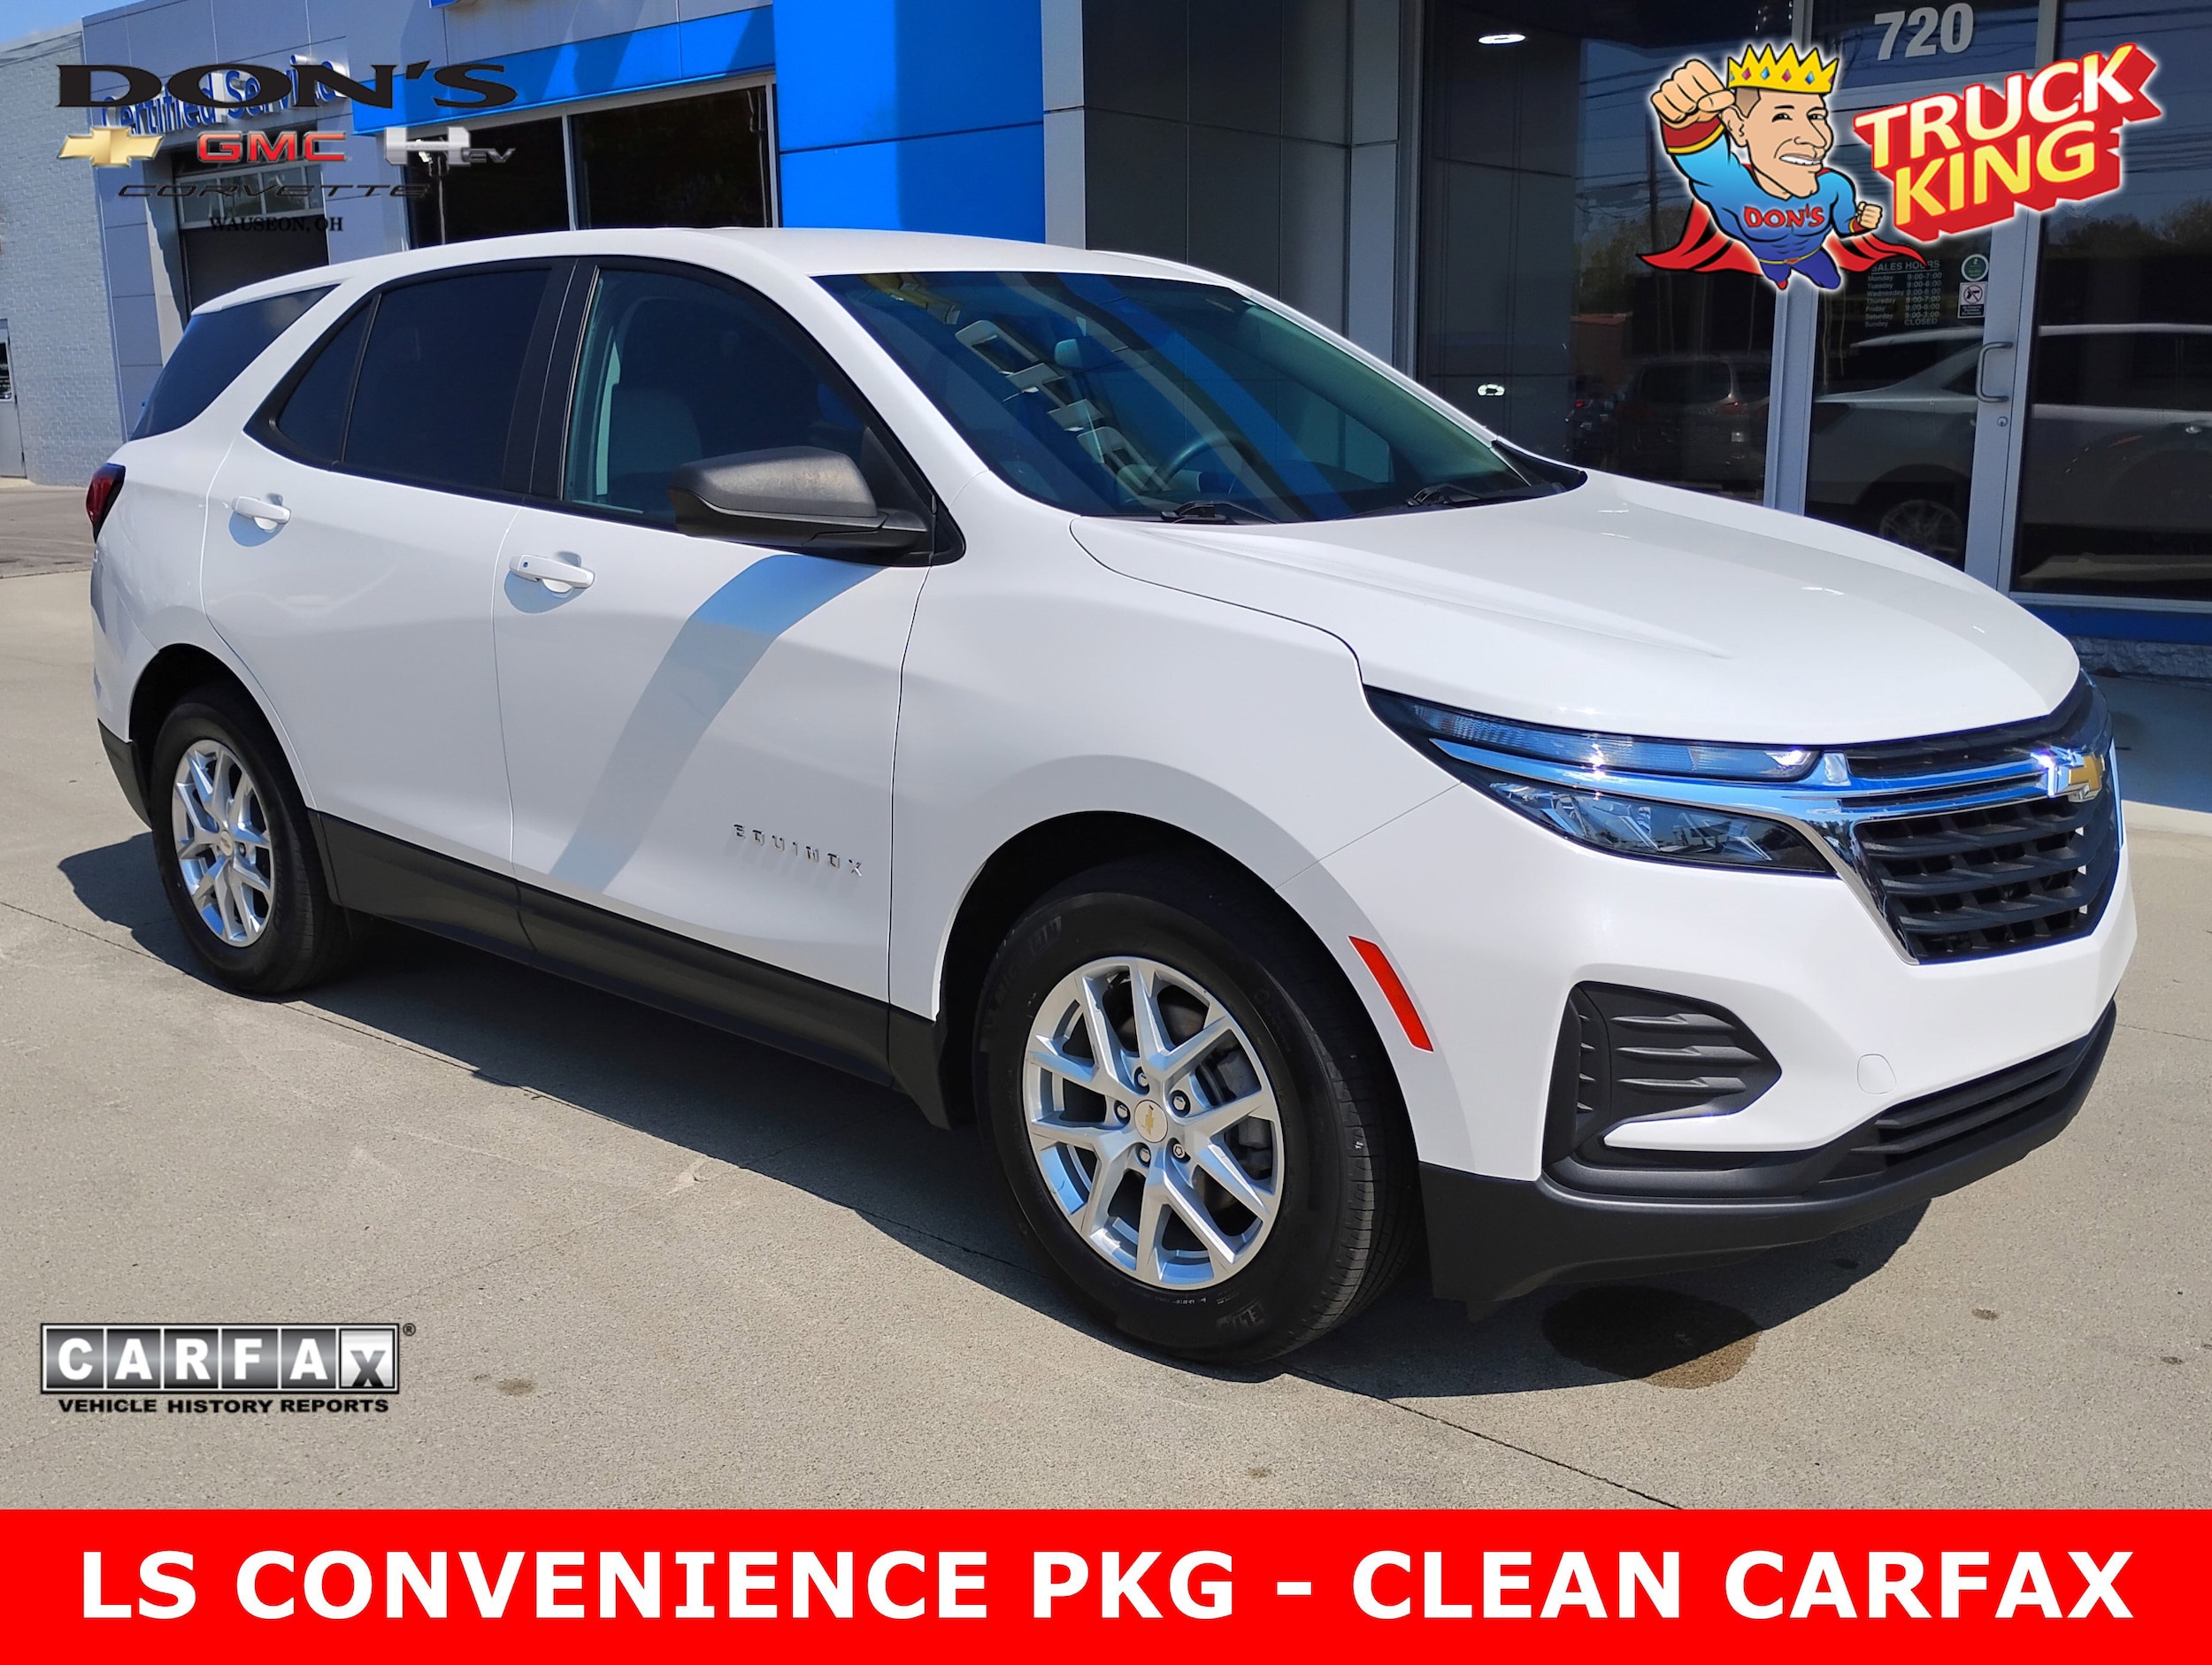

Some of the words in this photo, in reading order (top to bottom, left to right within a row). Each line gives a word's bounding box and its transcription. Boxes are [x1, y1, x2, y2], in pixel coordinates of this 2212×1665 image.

[1874, 3, 1974, 61] 720
[1870, 261, 1903, 272] SALES
[733, 824, 863, 877] EQUINOX
